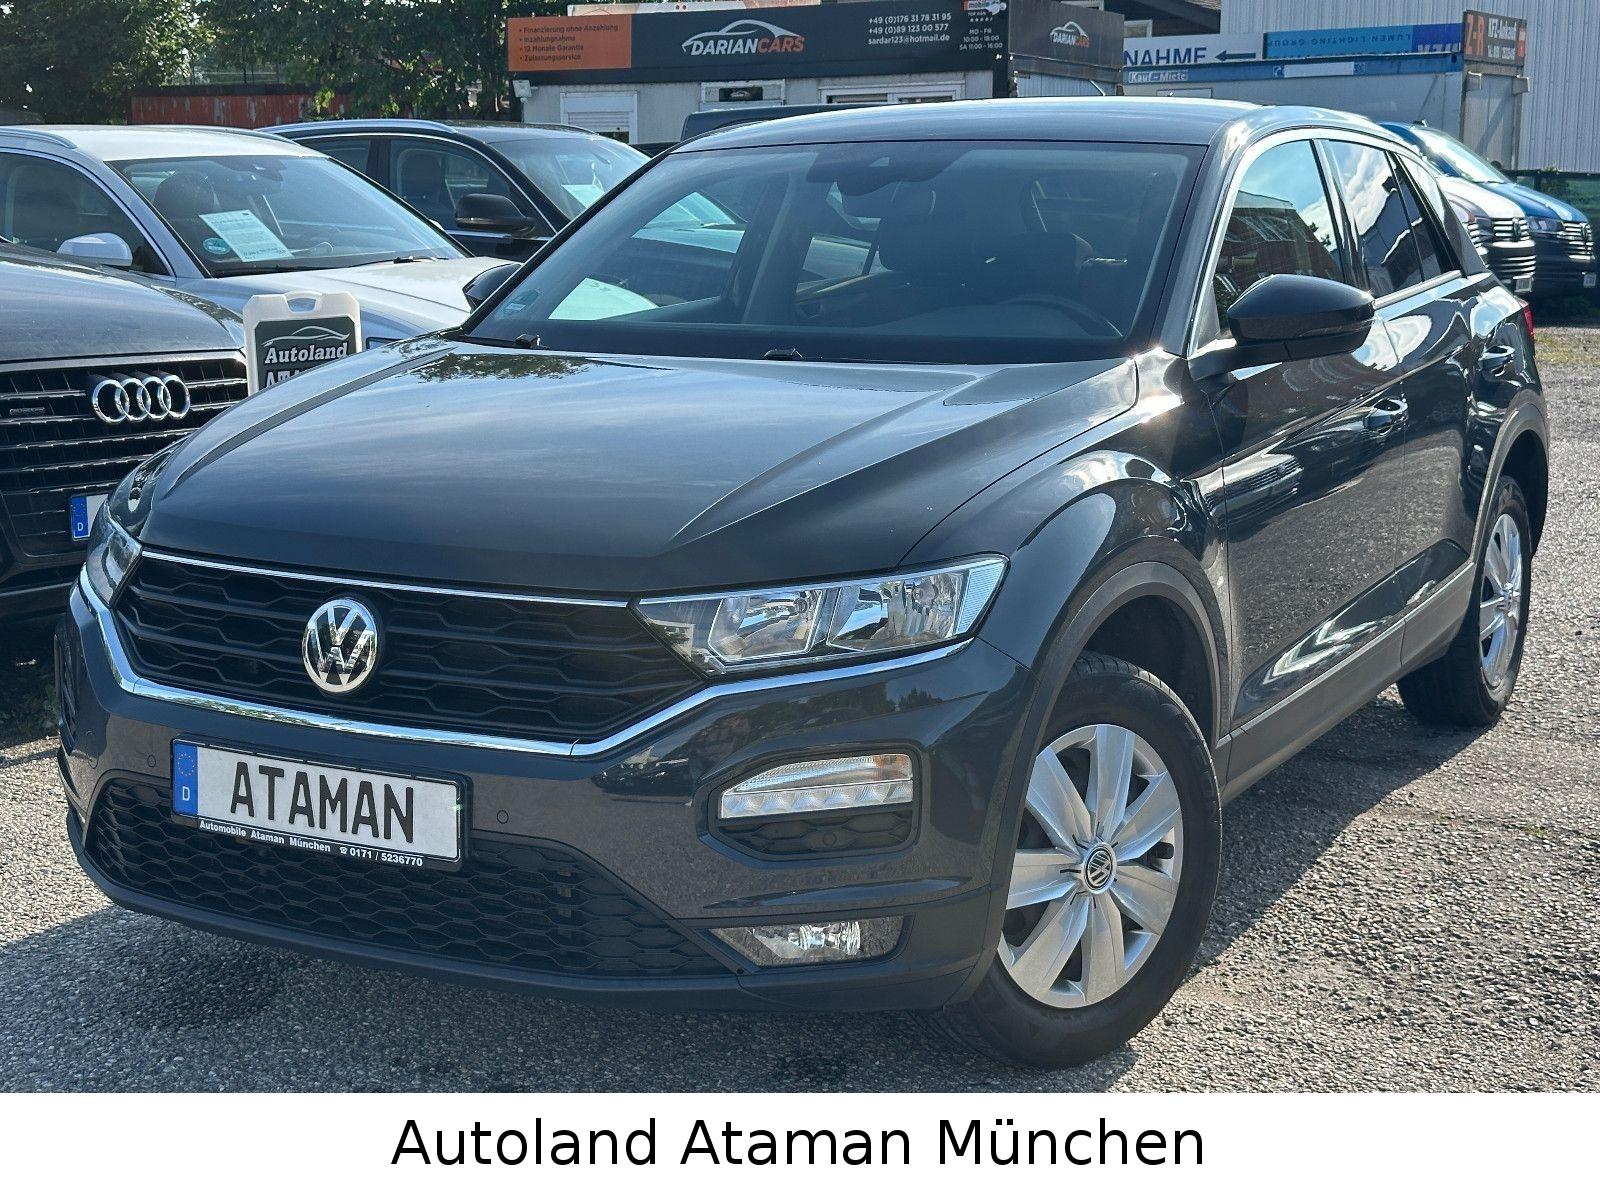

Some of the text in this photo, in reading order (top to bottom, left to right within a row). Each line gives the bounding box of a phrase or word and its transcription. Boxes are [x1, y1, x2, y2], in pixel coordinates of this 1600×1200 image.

[869, 12, 952, 24] +49 (0)176 31 78 31 95
[869, 23, 949, 34] +49 (0)89 123 00 577
[1311, 36, 1366, 46] LIGHTING
[1371, 34, 1411, 42] LUMEN
[691, 37, 805, 55] DARIANCARS
[524, 54, 581, 62] Zulassungsservice
[265, 342, 348, 364] Autoland
[77, 522, 84, 531] D
[182, 786, 190, 801] D
[230, 761, 414, 844] ATAMAN
[200, 820, 246, 837] Automobile
[250, 830, 285, 845] Ataman
[289, 837, 331, 852] München
[350, 847, 372, 859] 0171
[381, 852, 423, 867] 5236770
